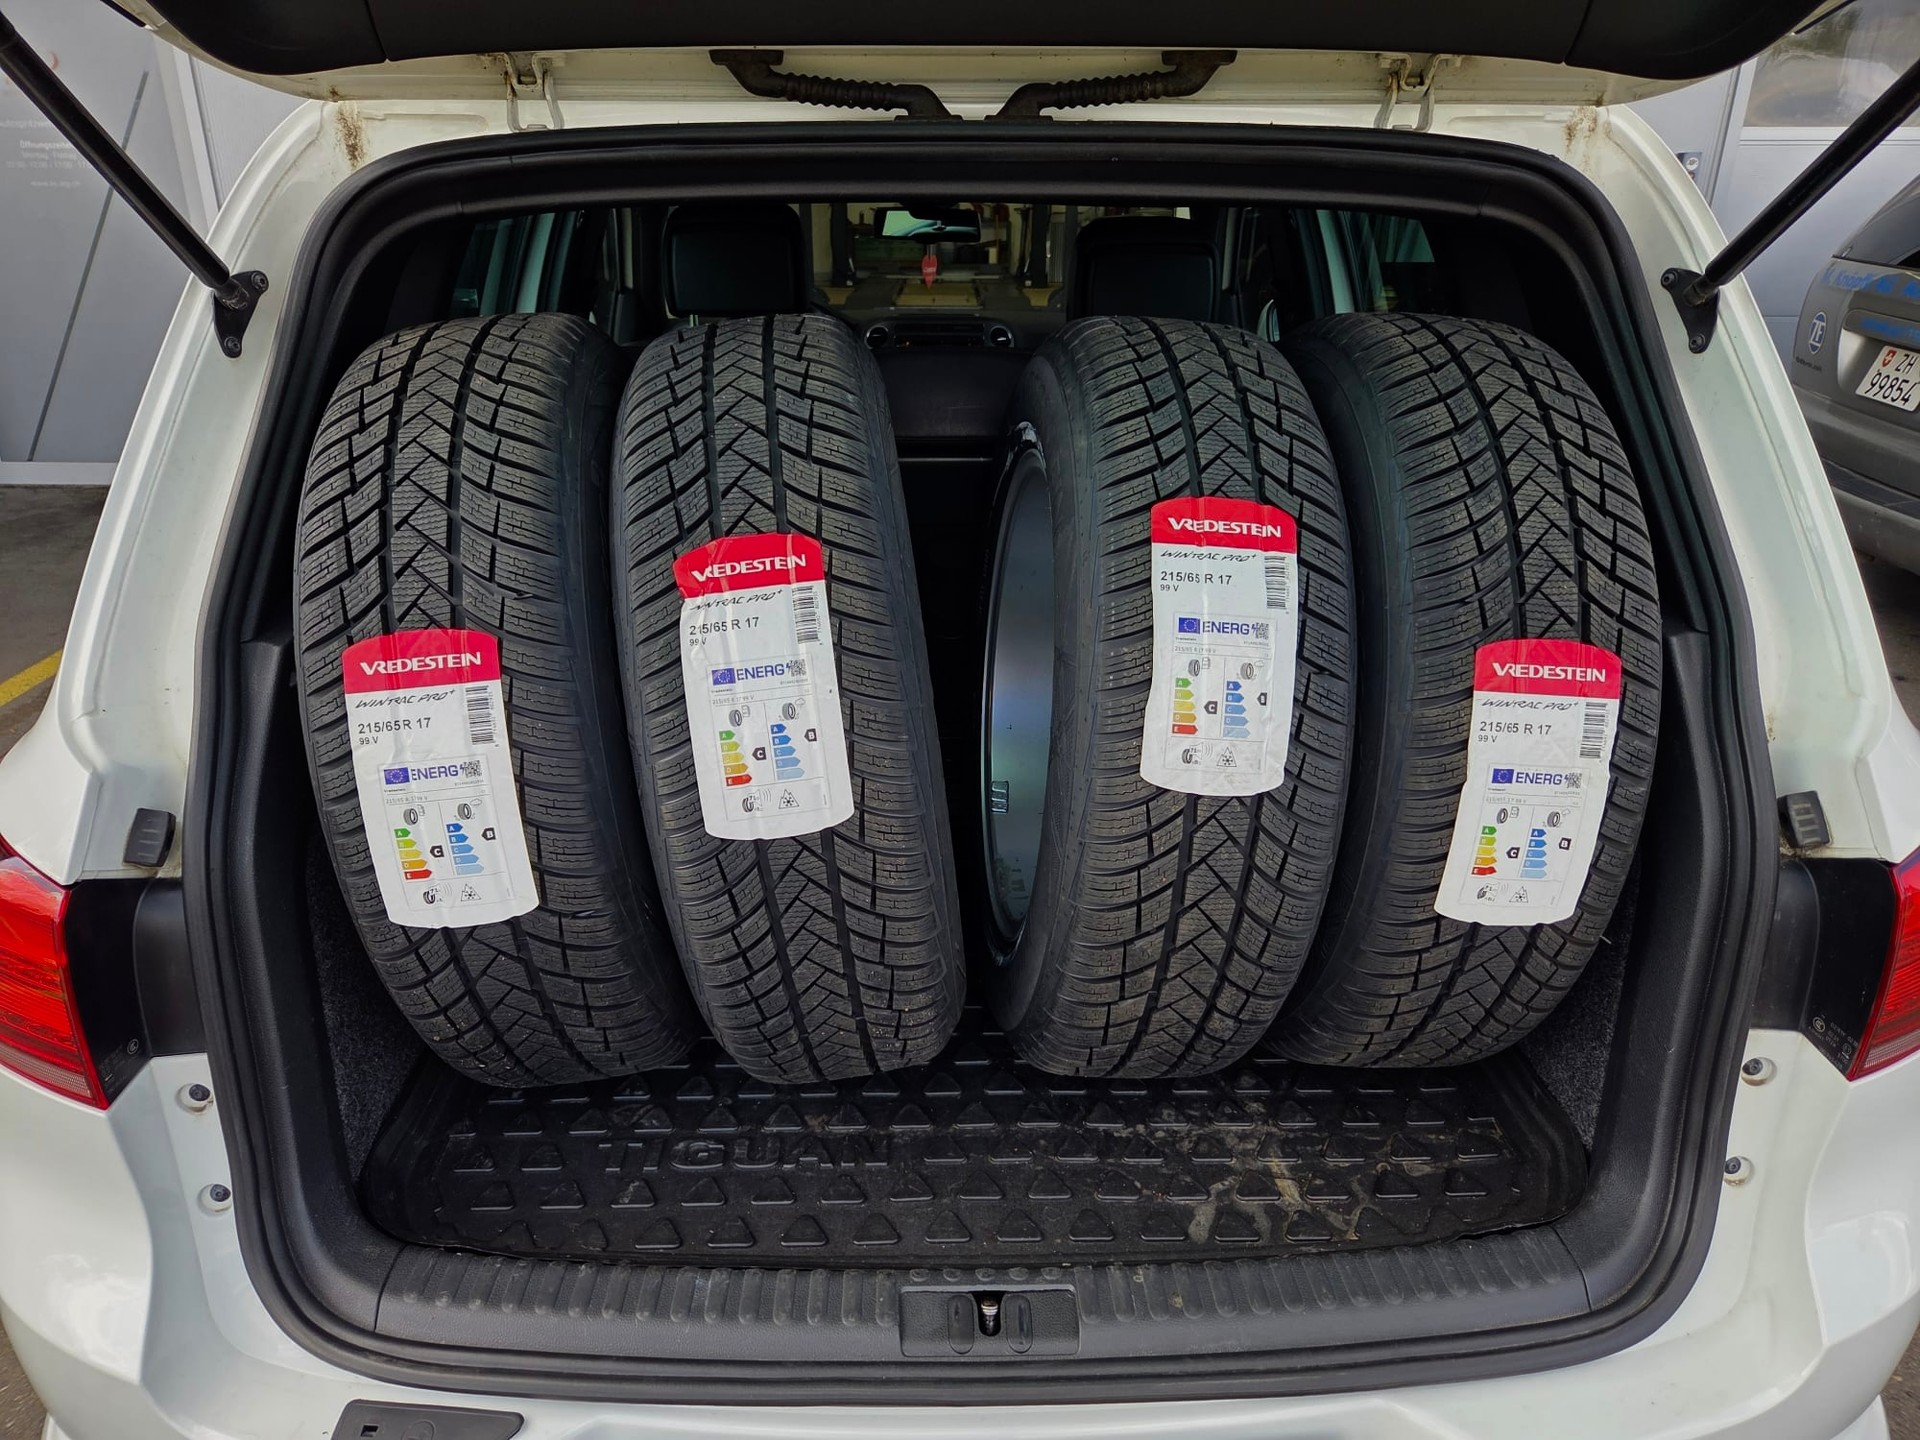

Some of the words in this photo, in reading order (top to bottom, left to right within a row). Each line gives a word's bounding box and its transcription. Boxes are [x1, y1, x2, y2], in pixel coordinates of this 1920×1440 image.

[1809, 318, 1826, 347] ZF
[1895, 354, 1919, 374] ZH
[1865, 372, 1920, 405] 99854
[1168, 517, 1281, 538] VREDESTEIN
[1160, 550, 1221, 561] WINTRAC
[1204, 574, 1214, 584] R
[1218, 575, 1232, 585] 17
[1172, 584, 1179, 592] V
[732, 619, 741, 630] R
[745, 617, 760, 628] 17
[1202, 621, 1250, 635] ENERG
[689, 638, 699, 646] 99
[701, 637, 708, 645] V
[360, 651, 481, 675] VREDESTEIN
[737, 664, 785, 681] ENERG
[1492, 662, 1606, 683] VREDESTEIN
[355, 695, 417, 709] WINTRAC
[417, 717, 431, 729] 17
[1480, 721, 1519, 734] 215/65
[1523, 723, 1533, 735] R
[1537, 724, 1552, 735] 17
[359, 737, 370, 745] 99
[372, 736, 379, 744] V
[411, 764, 459, 781] ENERG
[1515, 772, 1563, 785] ENERG
[597, 1138, 892, 1172] TIGUAN
